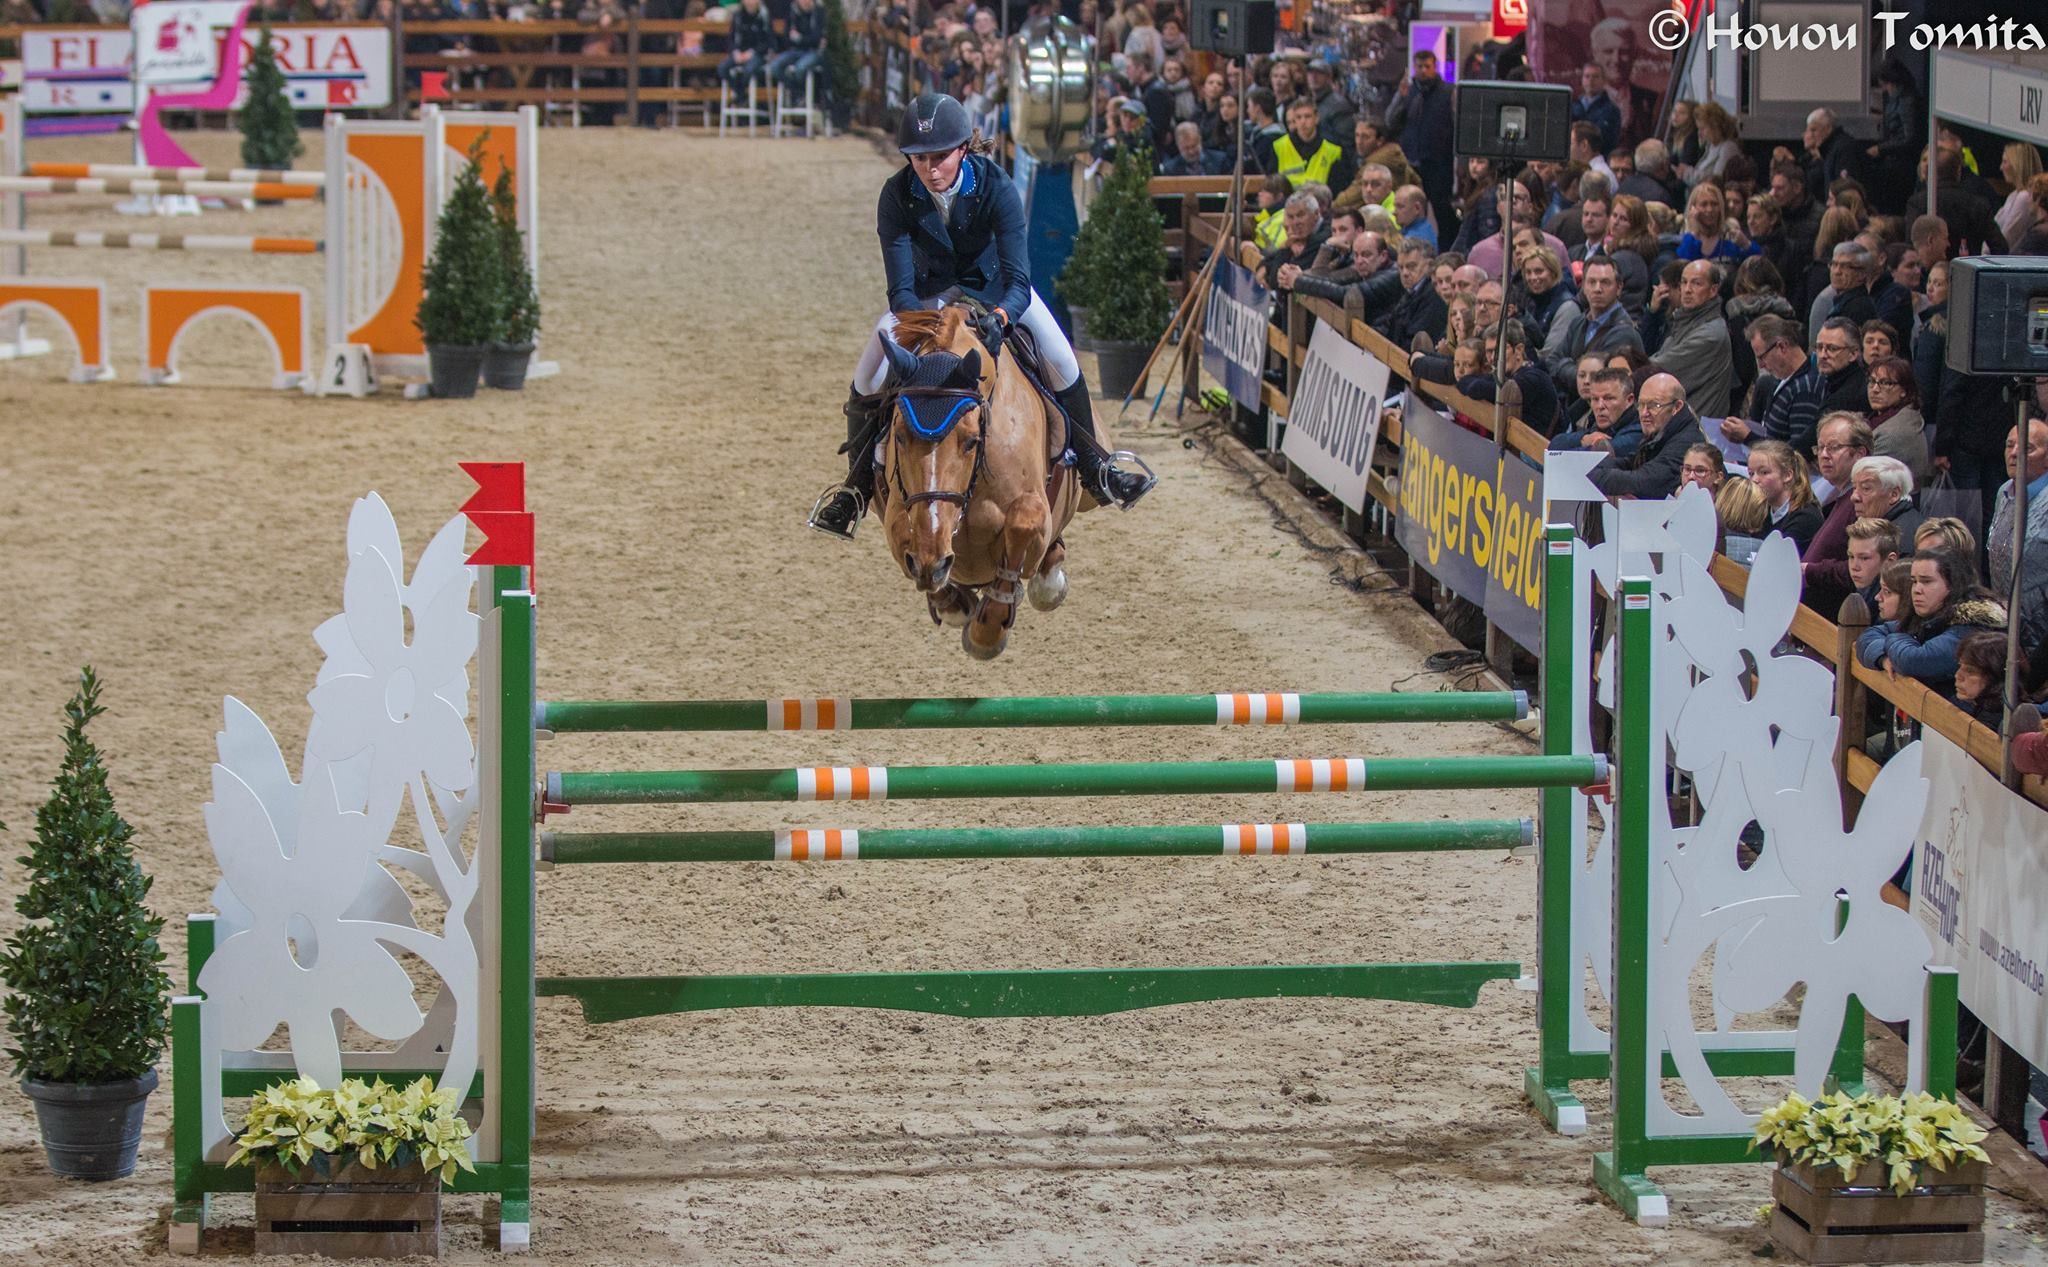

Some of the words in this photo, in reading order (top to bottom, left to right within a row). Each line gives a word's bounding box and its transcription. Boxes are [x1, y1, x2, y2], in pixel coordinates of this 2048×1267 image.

[2019, 84, 2043, 126] LRV
[333, 353, 347, 386] 2
[1205, 283, 1265, 378] LONGINES
[1292, 349, 1377, 476] SAMSUNG
[1400, 431, 1551, 611] zangersheid
[1979, 927, 2045, 996] www.azelhof.be
